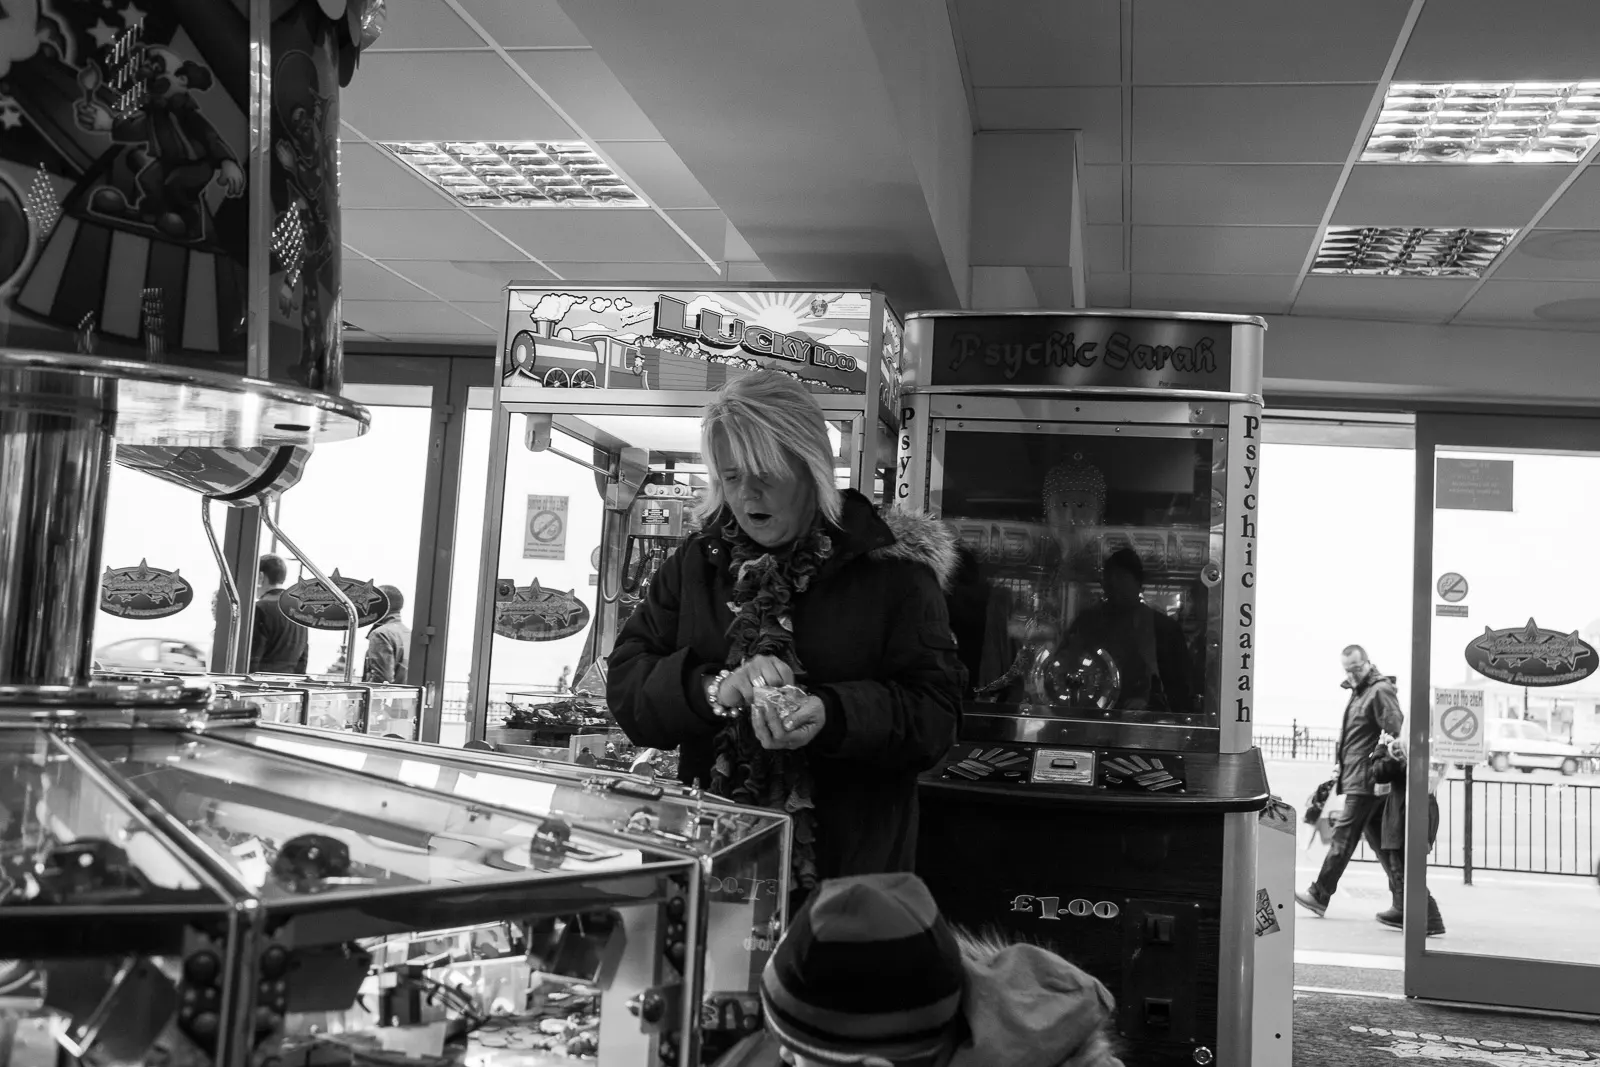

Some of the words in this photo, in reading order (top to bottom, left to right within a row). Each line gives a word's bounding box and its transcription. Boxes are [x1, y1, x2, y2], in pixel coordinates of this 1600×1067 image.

[949, 330, 1098, 380] Psychic
[1103, 331, 1217, 373] Sarah
[898, 407, 915, 499] Psyc
[1240, 415, 1259, 589] Psychic
[1235, 603, 1253, 723] Sarah
[1010, 895, 1119, 920] £1.00
